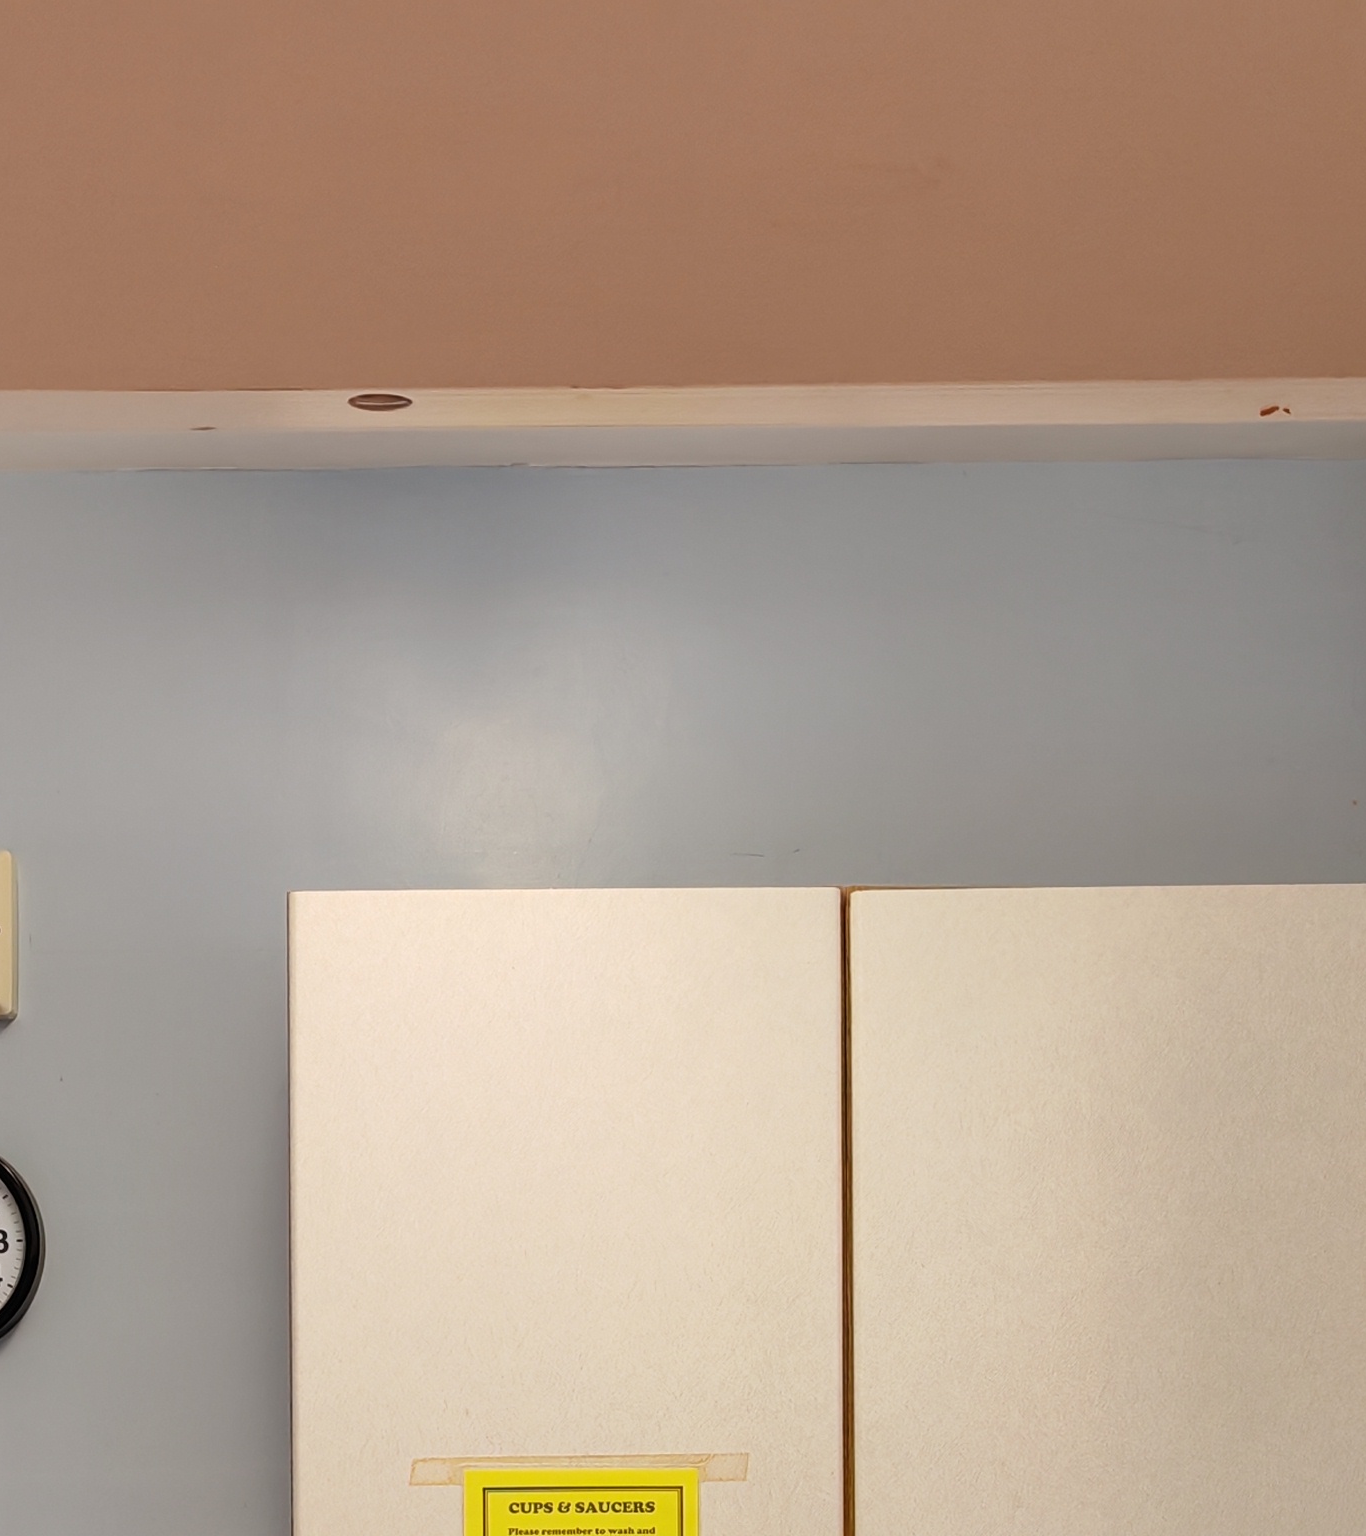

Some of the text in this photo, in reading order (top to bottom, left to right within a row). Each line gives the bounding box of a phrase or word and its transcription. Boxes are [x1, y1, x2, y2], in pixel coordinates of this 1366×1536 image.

[508, 1500, 656, 1514] CUPS & SAUCERS
[508, 1526, 656, 1536] Please remember to wash and
